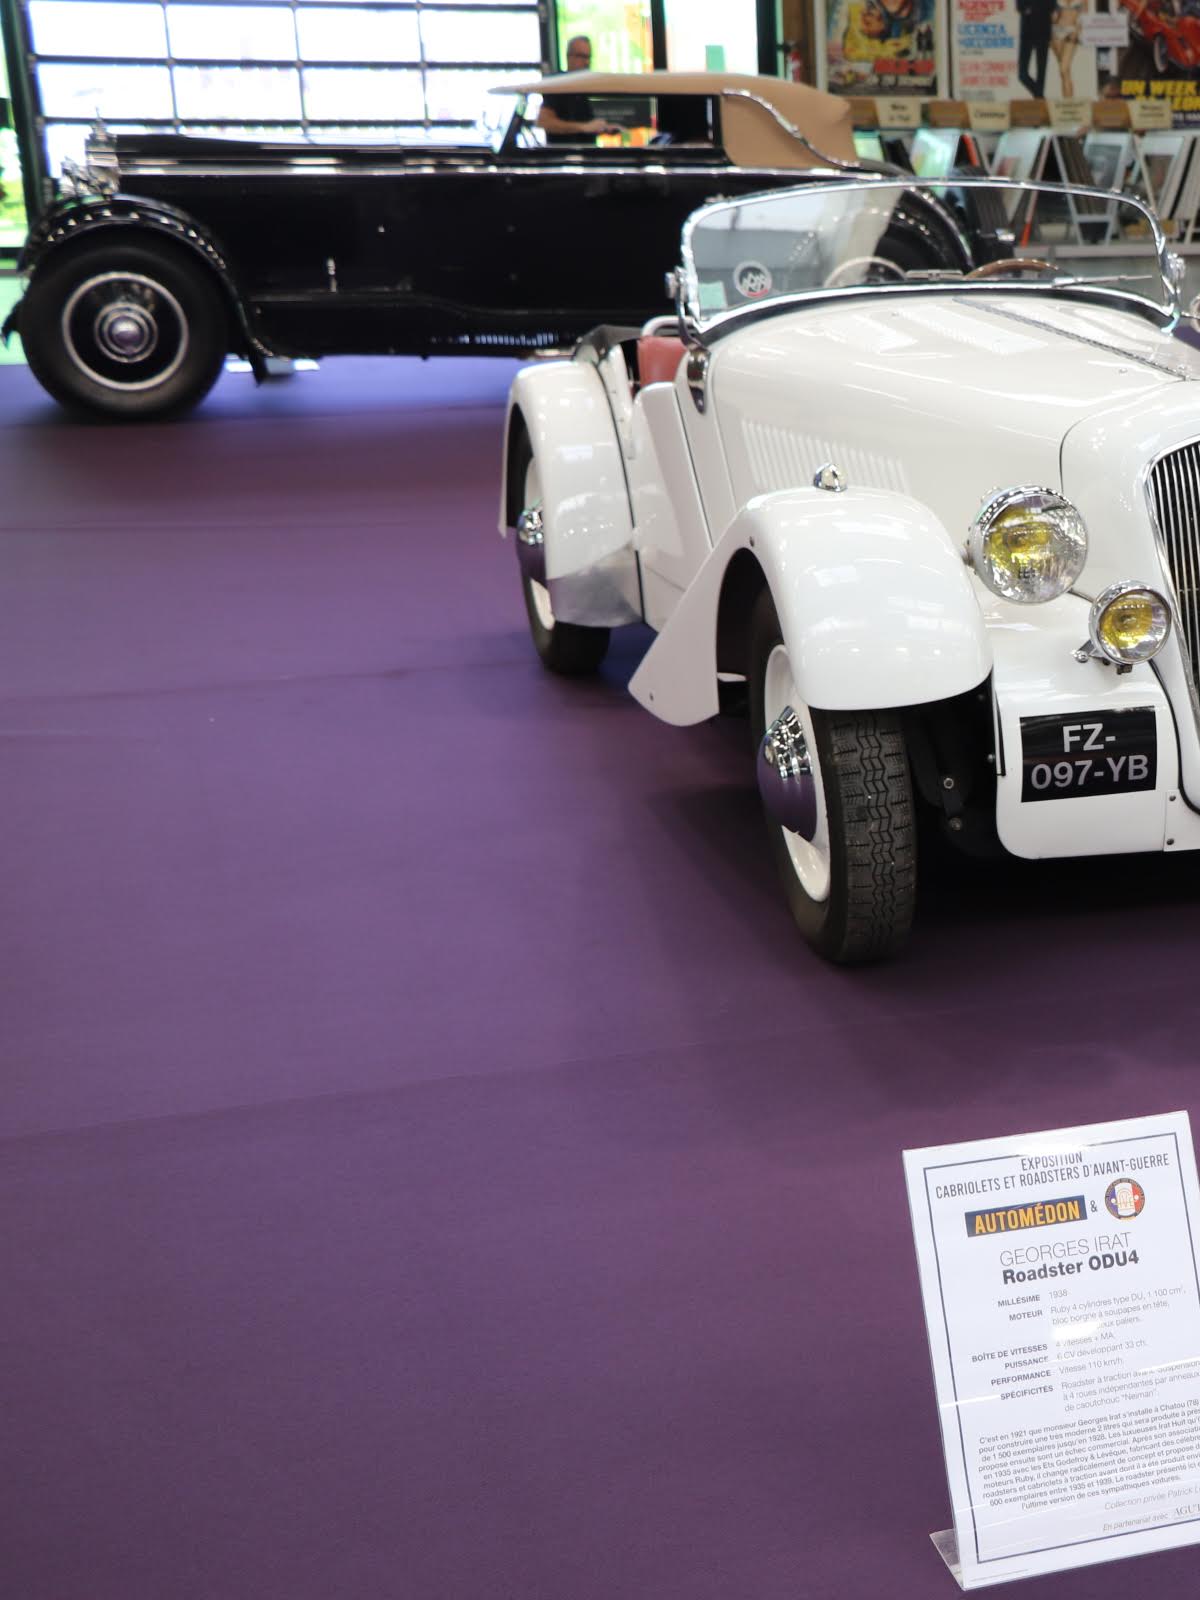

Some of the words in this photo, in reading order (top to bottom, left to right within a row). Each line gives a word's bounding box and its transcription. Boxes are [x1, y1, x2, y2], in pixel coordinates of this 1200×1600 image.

[1149, 80, 1197, 96] WEEK
[1063, 723, 1116, 753] FZ-
[1031, 754, 1149, 790] 097-YB
[936, 1178, 1000, 1199] CABRIOLETS
[1004, 1176, 1015, 1189] ET
[1020, 1167, 1079, 1187] ROADSTERS
[1083, 1154, 1169, 1178] D'AVANT-GUERRE
[975, 1198, 1081, 1234] AUTOMÉDON
[1089, 1200, 1098, 1212] &
[1000, 1239, 1088, 1267] GEORGES
[1094, 1232, 1132, 1252] IRAT
[1004, 1261, 1083, 1284] Roadster
[1090, 1250, 1137, 1271] ODU4
[1009, 1309, 1043, 1321] MOTEUR
[972, 1353, 996, 1362] BOÎTE
[1010, 1344, 1048, 1356] VITESSES
[1004, 1356, 1049, 1369] PUISSANCE
[991, 1369, 1052, 1386] PERFORMANCE
[979, 1446, 995, 1455] pour
[997, 1440, 1033, 1450] construire
[1065, 1428, 1096, 1438] moderne
[1122, 1420, 1133, 1429] qui
[1151, 1413, 1180, 1424] produite
[980, 1435, 998, 1444] C'est
[1010, 1430, 1027, 1439] 1921
[1028, 1429, 1042, 1437] que
[1078, 1417, 1108, 1426] Georges
[1109, 1413, 1121, 1421] Irat
[1123, 1408, 1153, 1418] s'installe
[1160, 1403, 1185, 1412] Chatou
[1013, 1444, 1055, 1456] exemplaires
[1158, 1422, 1170, 1430] Irat
[1172, 1419, 1186, 1427] Huit
[984, 1480, 1013, 1489] moteurs
[1015, 1475, 1036, 1483] Ruby,
[1042, 1469, 1068, 1478] change
[1070, 1459, 1116, 1473] radicalement
[1127, 1452, 1156, 1463] concept
[1166, 1446, 1194, 1457] propose
